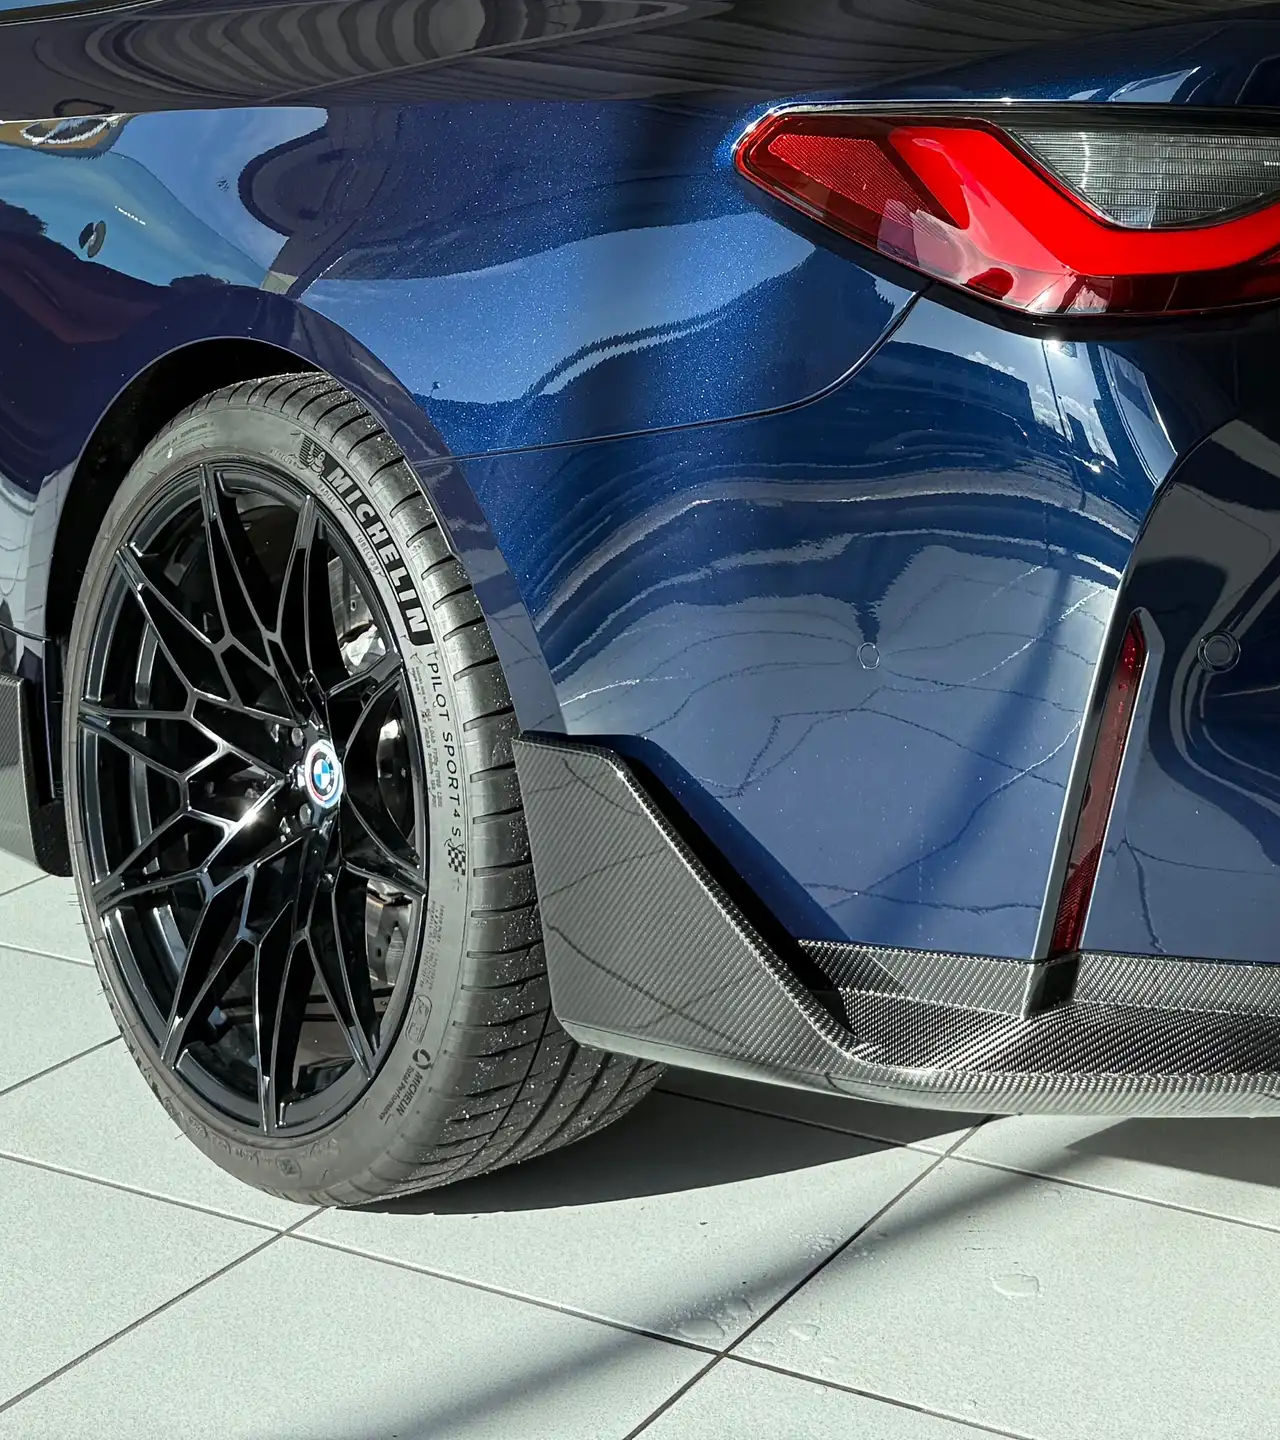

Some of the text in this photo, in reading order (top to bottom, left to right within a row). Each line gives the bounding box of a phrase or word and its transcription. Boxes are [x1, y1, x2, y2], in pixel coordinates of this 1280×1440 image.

[327, 467, 428, 633] MICHELIN
[427, 662, 461, 837] PILOT SPORT 4 S
[396, 1071, 423, 1116] MICHELIN
